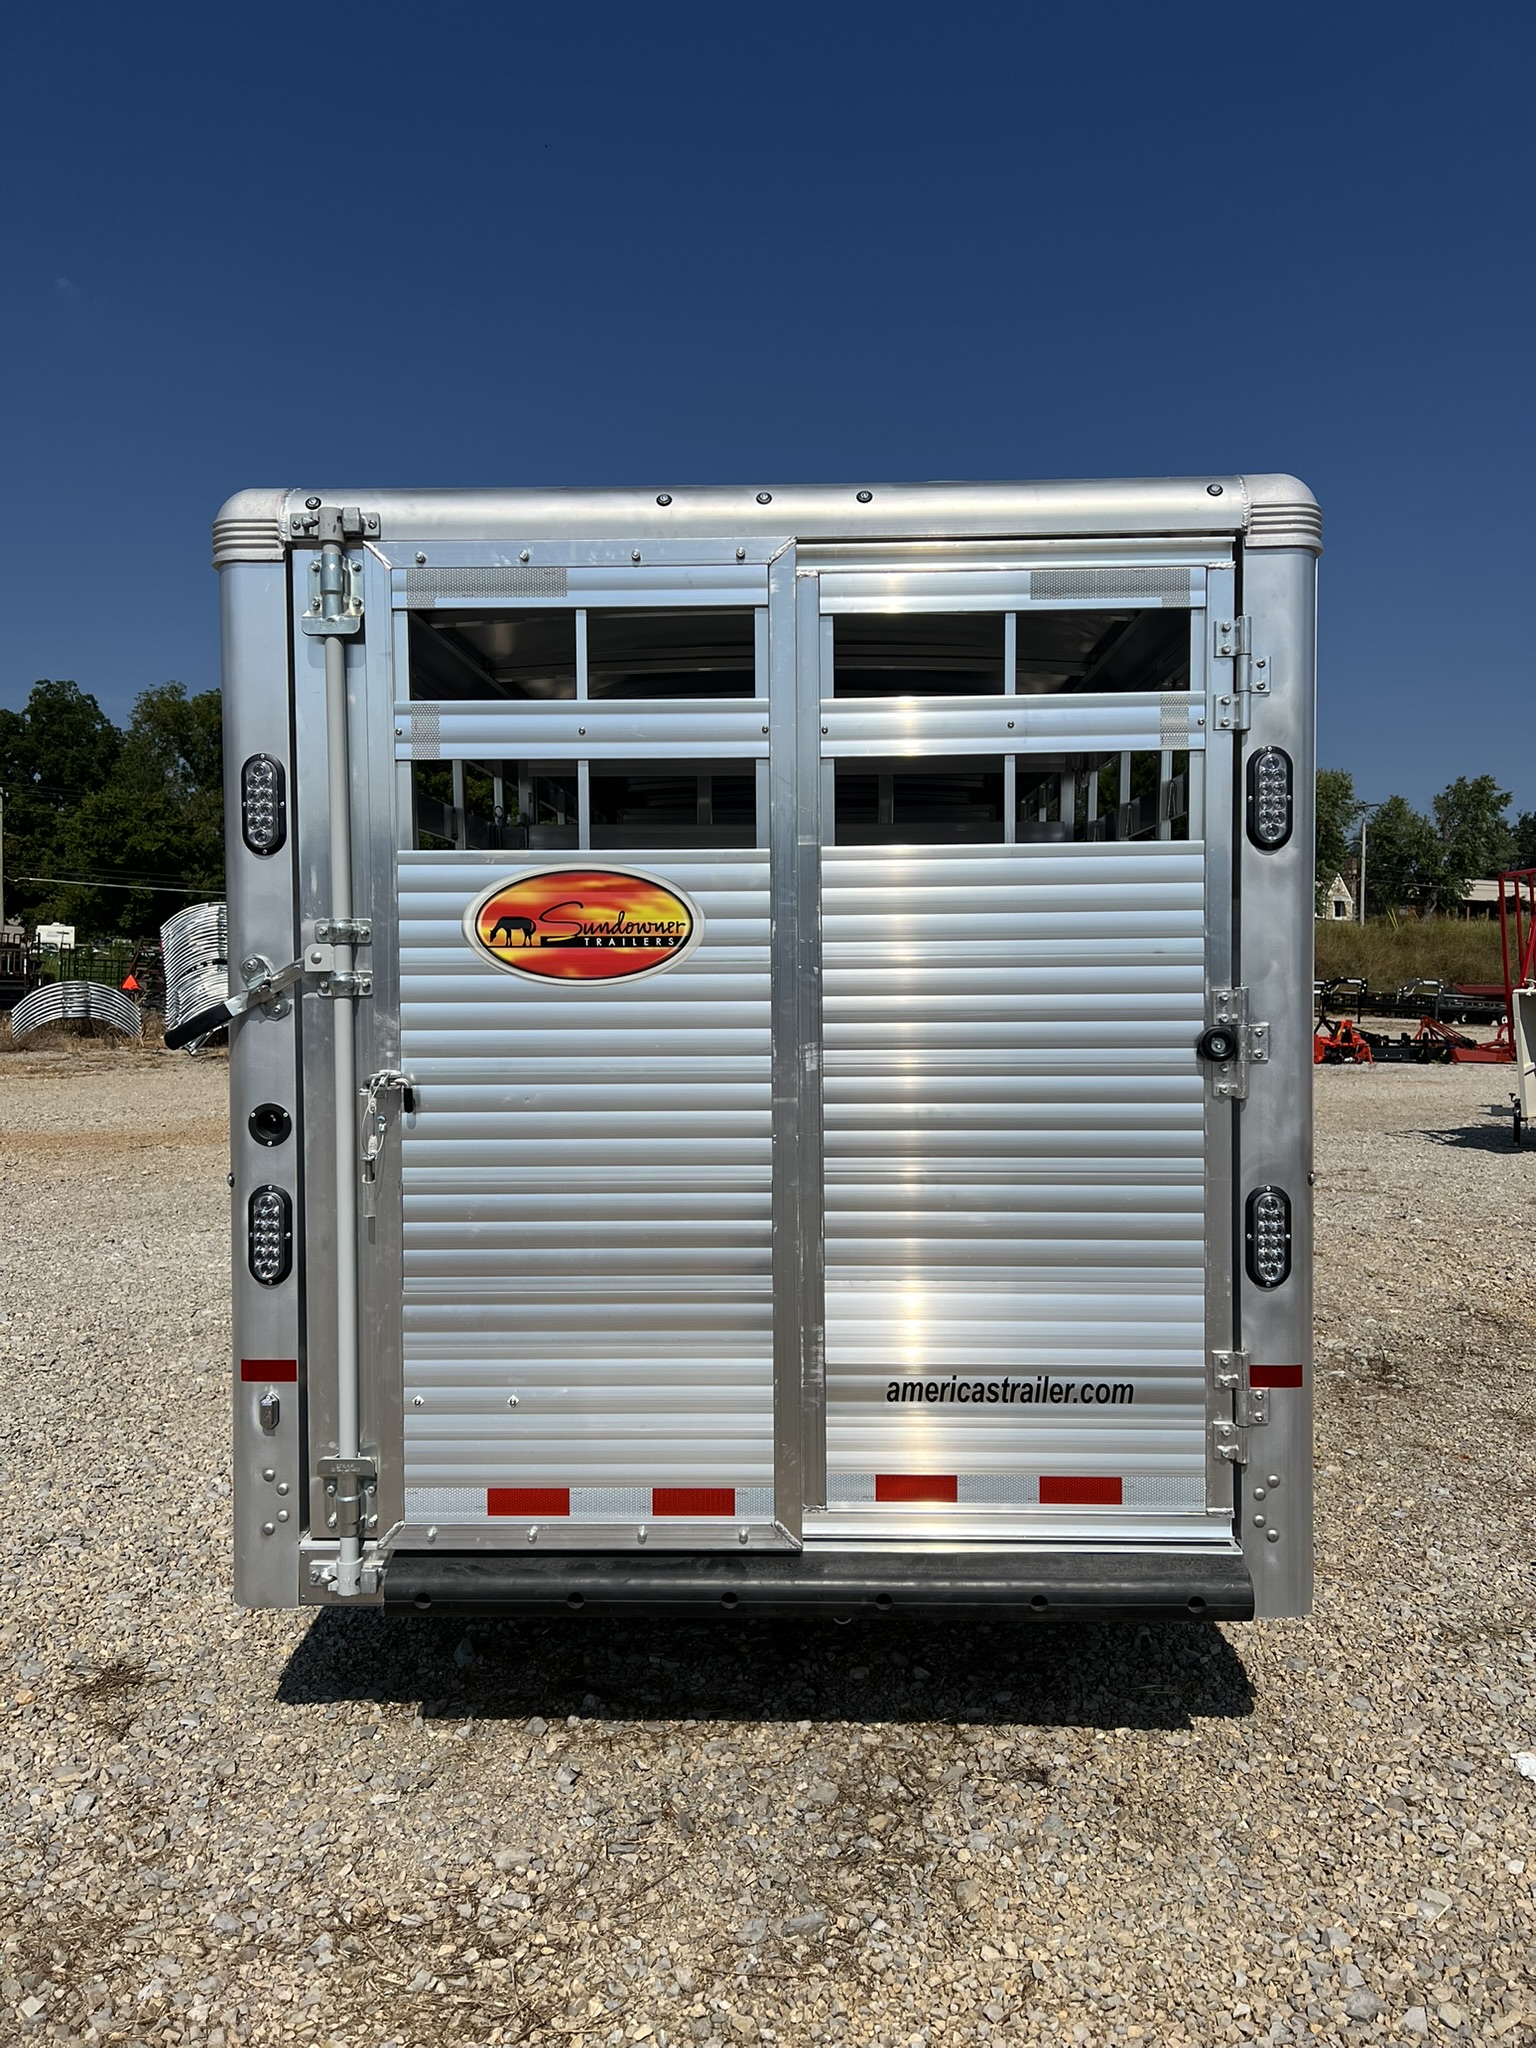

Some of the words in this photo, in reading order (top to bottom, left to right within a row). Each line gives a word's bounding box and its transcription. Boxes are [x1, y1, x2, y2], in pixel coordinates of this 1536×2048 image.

[539, 901, 686, 942] Sundowner
[584, 937, 675, 947] TRAILERS
[886, 1374, 1134, 1404] americastrailer.com
